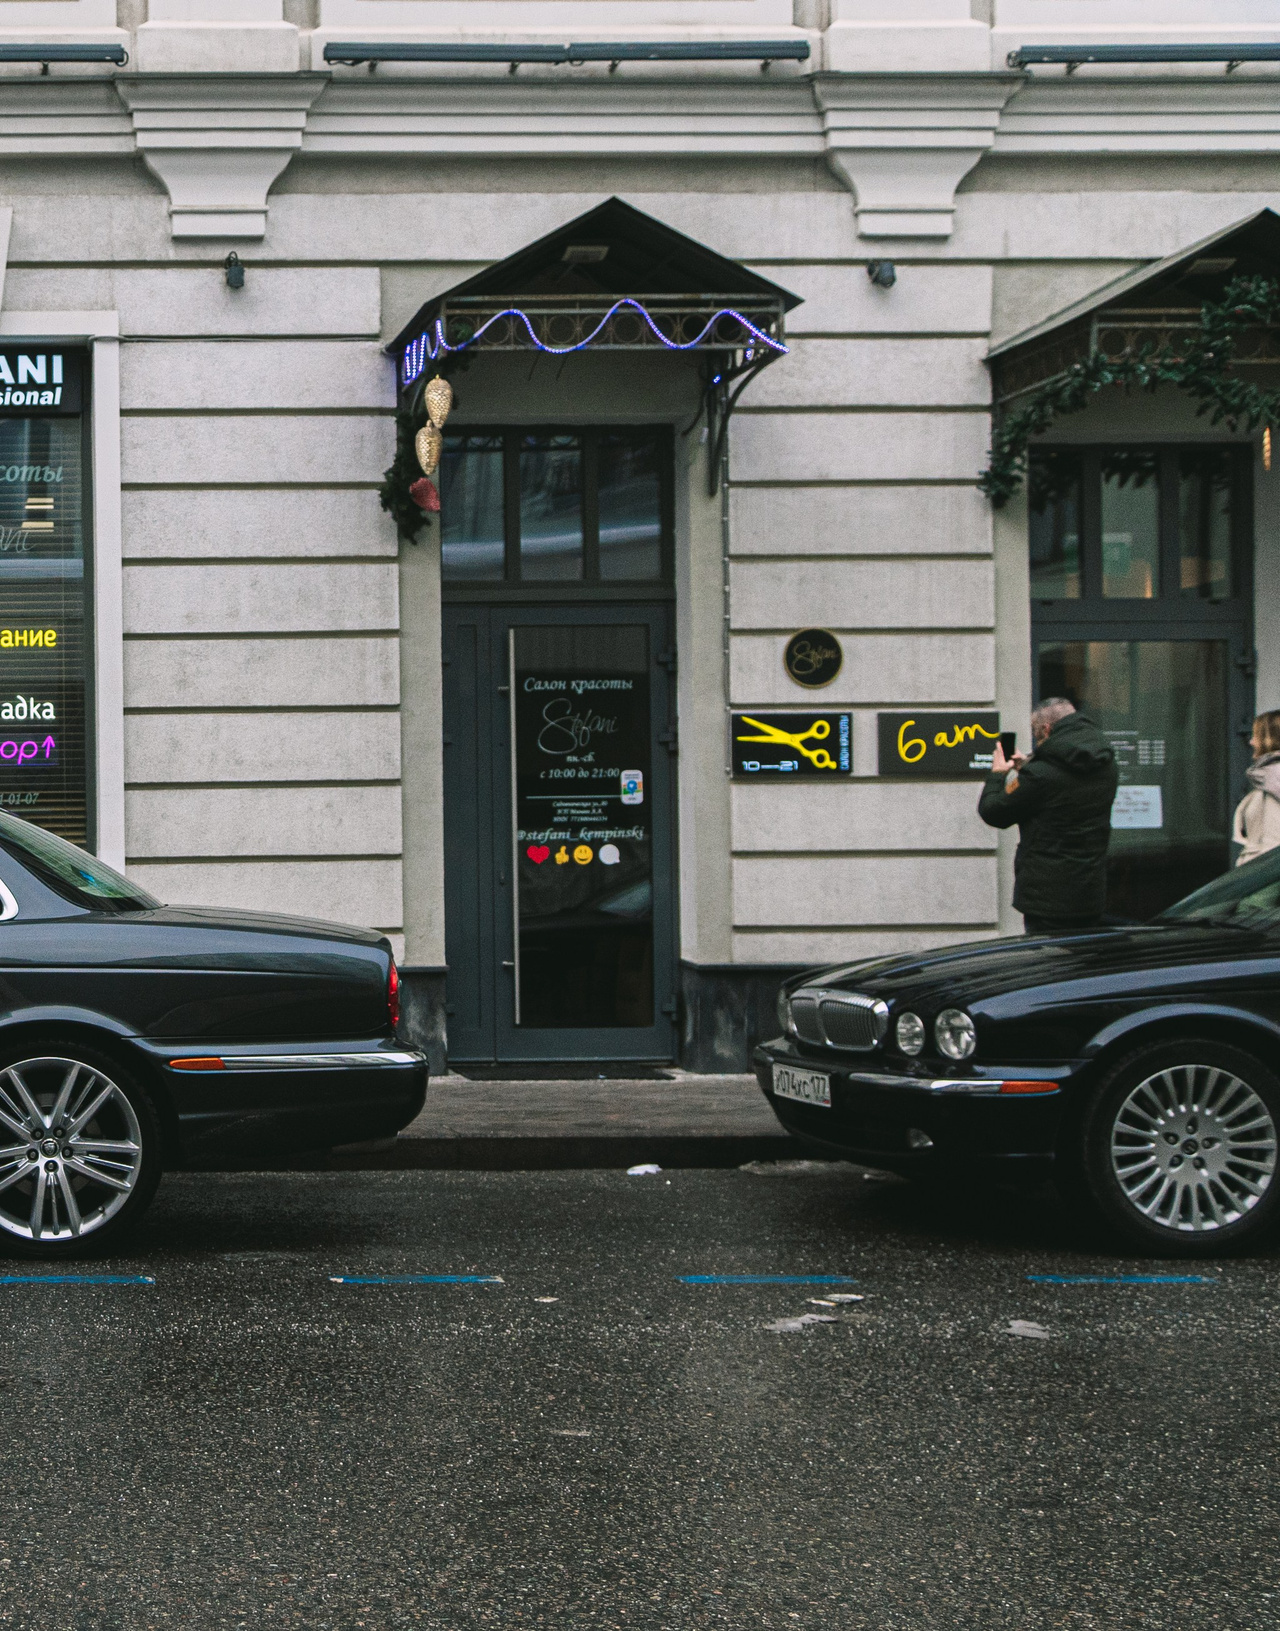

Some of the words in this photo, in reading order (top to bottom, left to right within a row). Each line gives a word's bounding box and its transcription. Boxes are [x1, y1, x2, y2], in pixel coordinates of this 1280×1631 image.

[524, 677, 566, 692] Салон
[571, 680, 633, 694] красоты
[537, 698, 618, 754] Stefani
[897, 720, 927, 763] 6
[934, 724, 1000, 748] am
[548, 769, 576, 778] 10:00
[578, 767, 590, 778] до
[591, 768, 620, 778] 21:00
